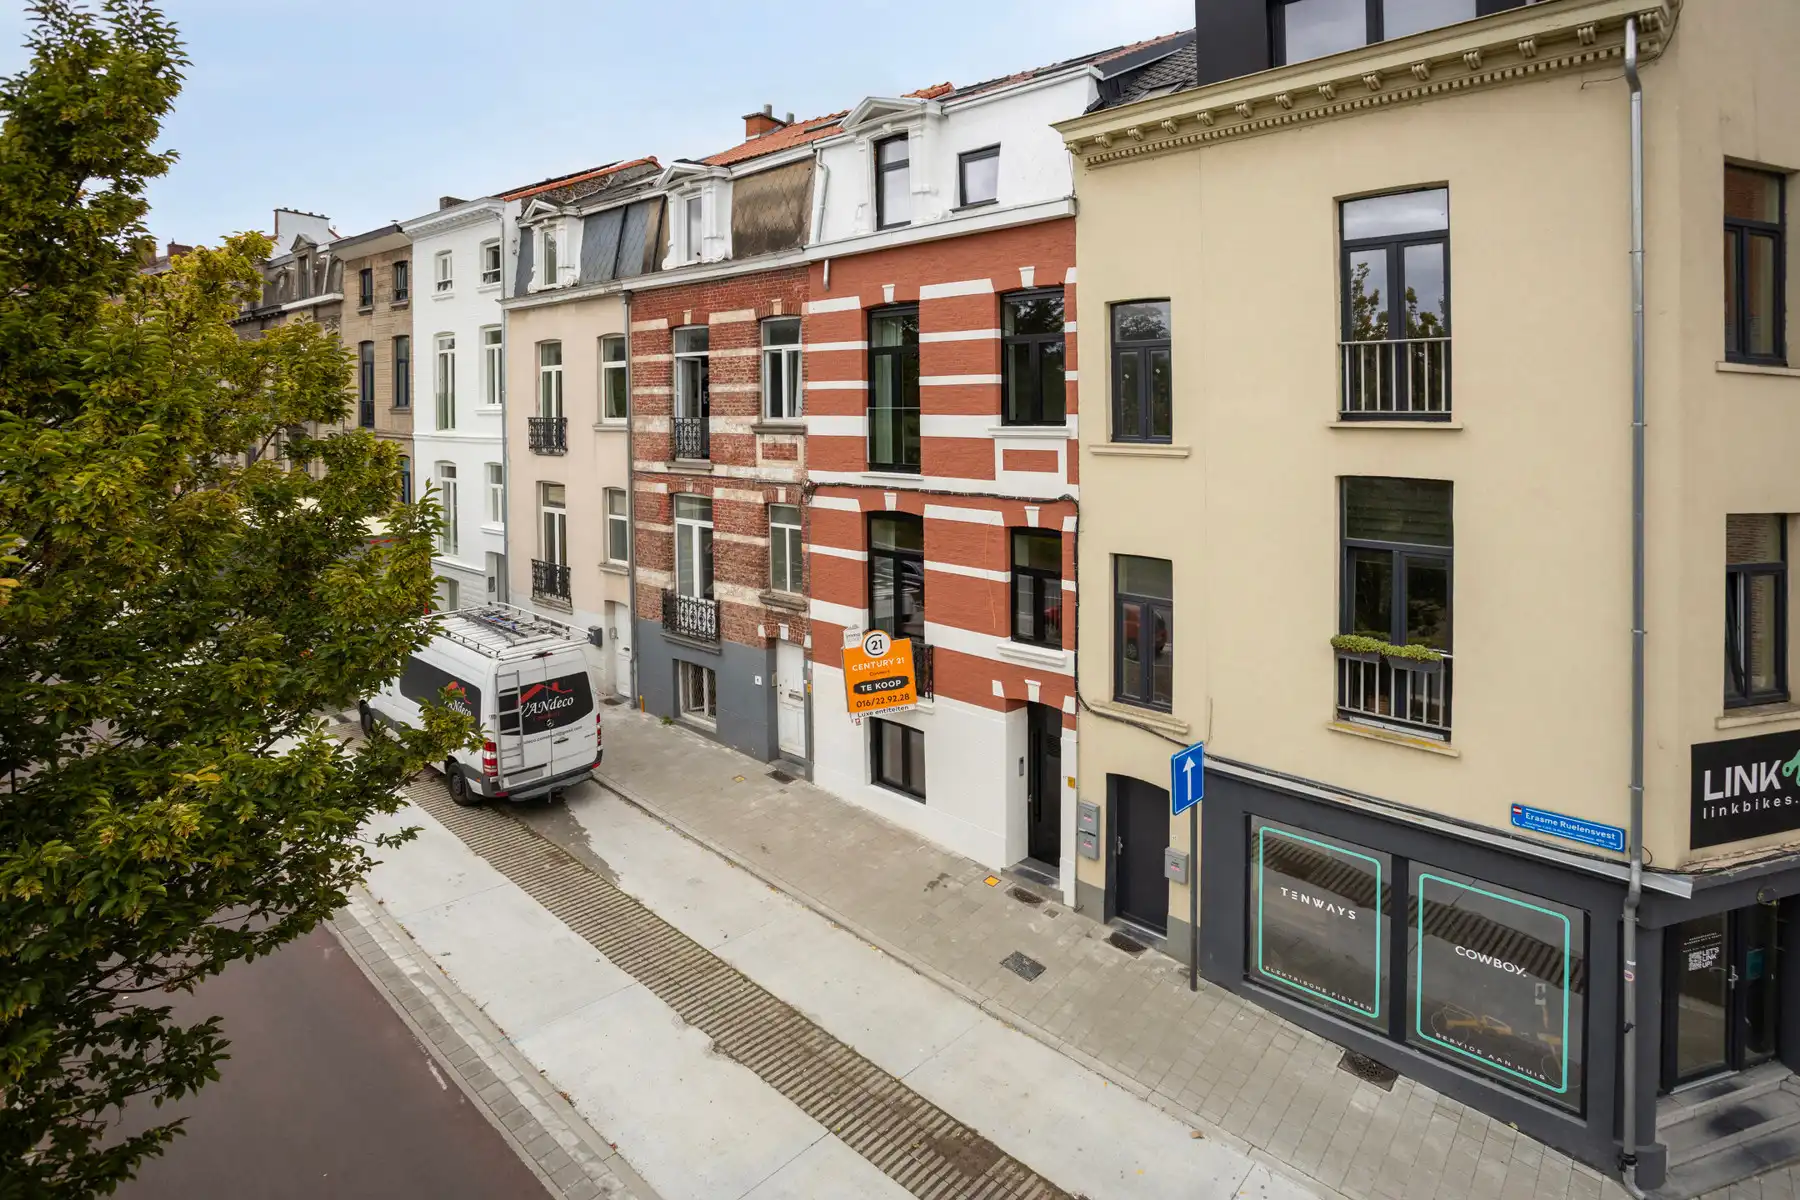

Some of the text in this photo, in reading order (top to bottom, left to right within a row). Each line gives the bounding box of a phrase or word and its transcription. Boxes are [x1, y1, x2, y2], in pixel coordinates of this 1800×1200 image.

[852, 658, 894, 671] CENTURY
[860, 679, 902, 692] TE KOOP
[856, 693, 910, 708] 016/22.92.28
[857, 705, 909, 718] Luxe entiteiten
[1703, 760, 1782, 802] LINK
[1525, 812, 1559, 827] Erasme
[1560, 820, 1616, 840] Ruelensvest
[1280, 886, 1357, 920] TENWAYS
[1331, 991, 1373, 1012] FIETSEN
[1435, 1032, 1546, 1081] SERVICE AAN HUIS
